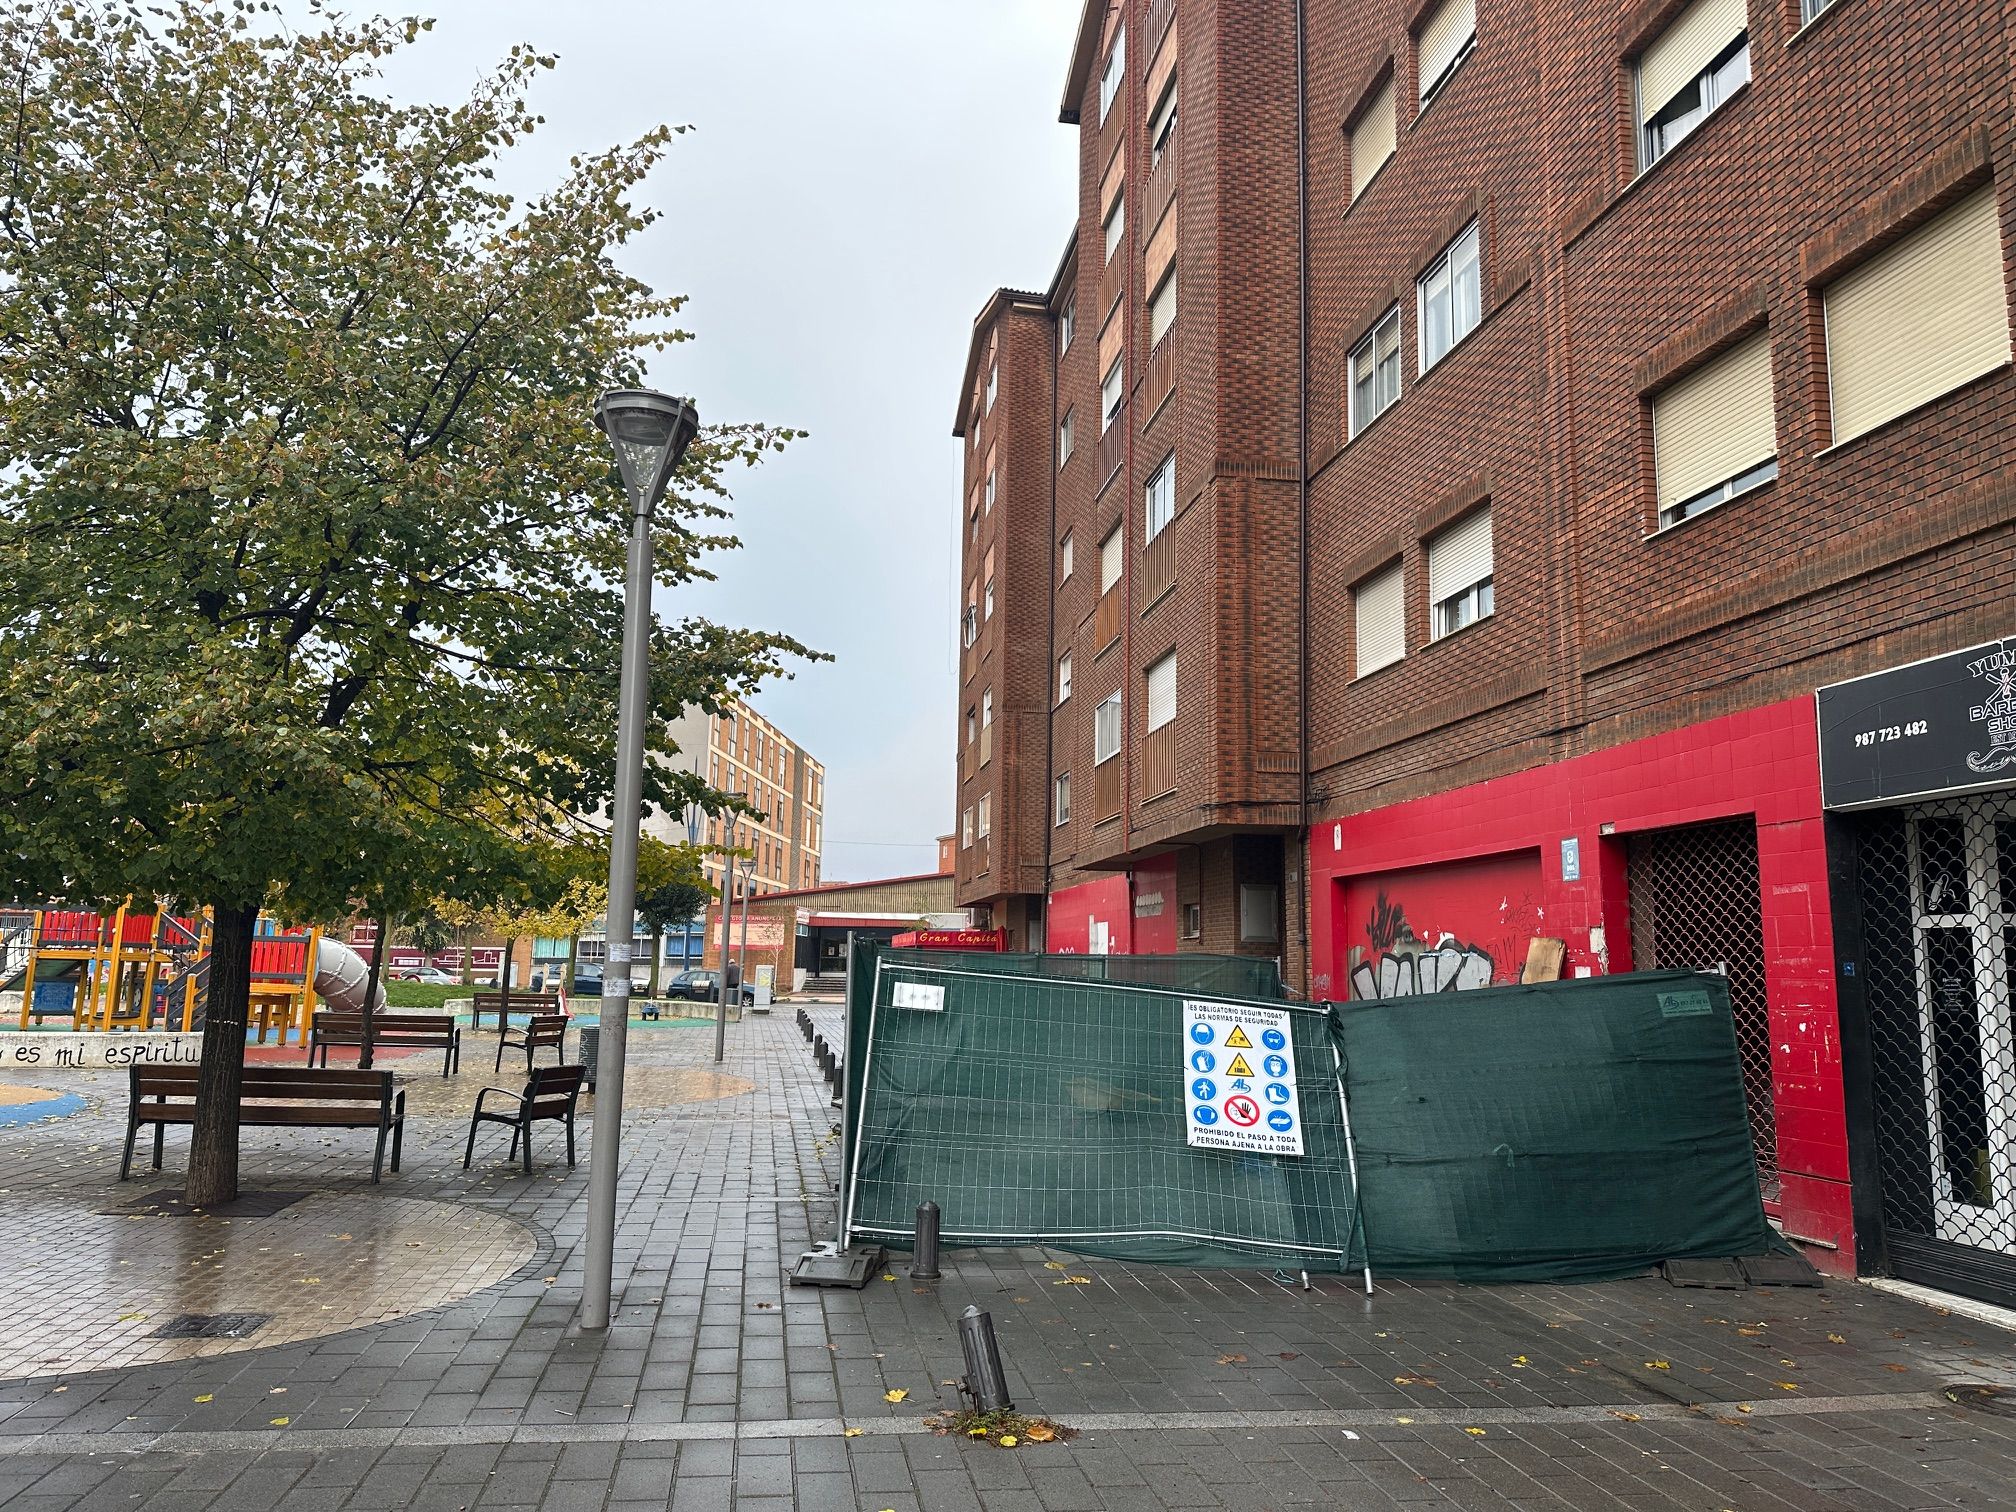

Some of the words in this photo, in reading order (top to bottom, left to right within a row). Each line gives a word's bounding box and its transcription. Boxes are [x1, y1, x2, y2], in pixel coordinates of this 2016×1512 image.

[1854, 730, 1876, 748] 987
[1878, 725, 1901, 742] 723
[1904, 719, 1928, 737] 482
[919, 932, 949, 943] Gran
[1199, 1005, 1239, 1014] OBLIGATORIO
[1240, 1009, 1262, 1017] SEGUIR
[1207, 1014, 1233, 1022] NORMAS
[1244, 1017, 1278, 1026] SEGURIDAD
[15, 1046, 41, 1063] es
[55, 1042, 86, 1067] mi
[1193, 1127, 1235, 1137] PROHIBIDO
[1247, 1133, 1267, 1141] PASO
[1196, 1136, 1230, 1146] PERSONA
[1232, 1140, 1255, 1149] AJENA
